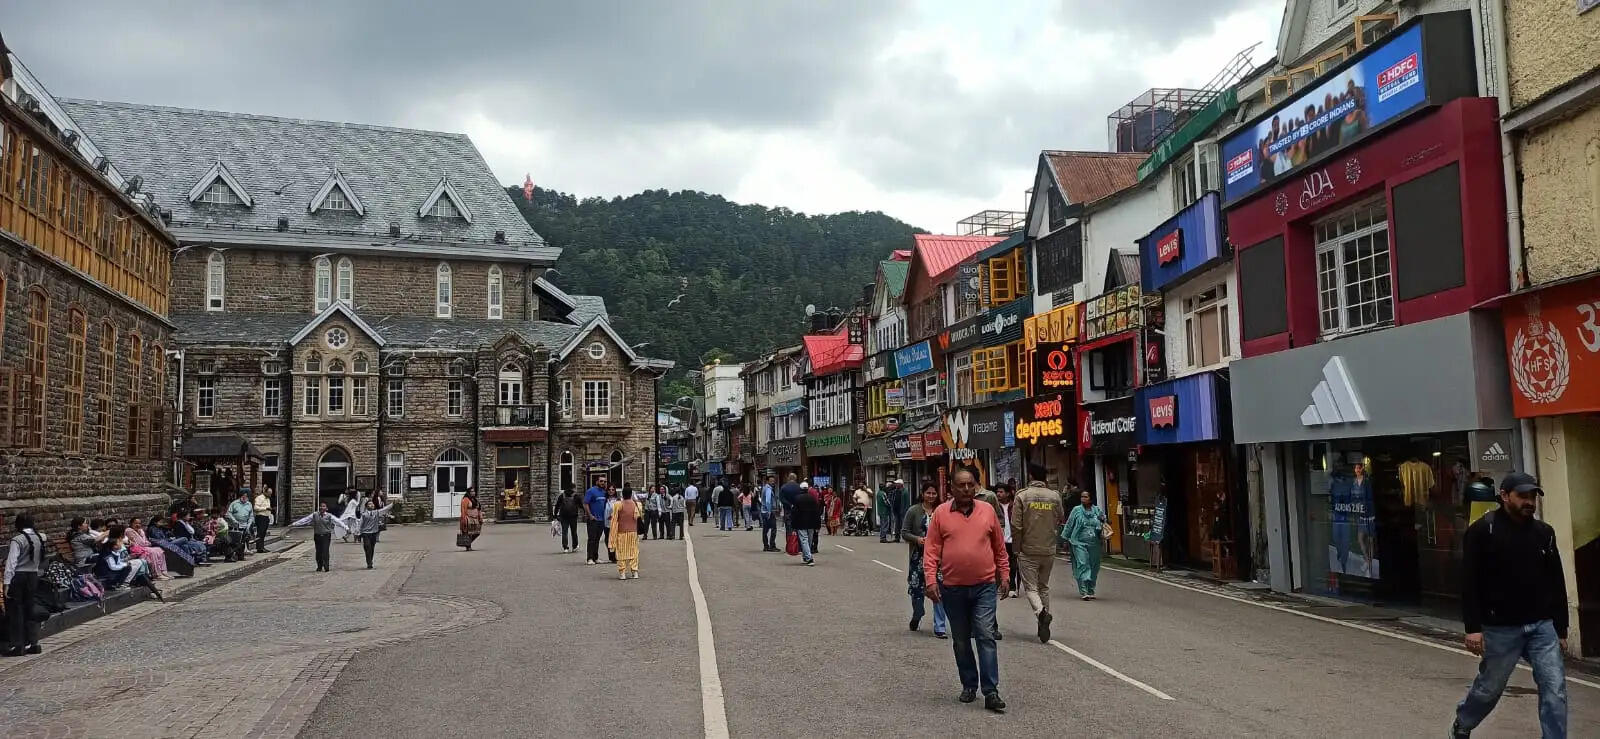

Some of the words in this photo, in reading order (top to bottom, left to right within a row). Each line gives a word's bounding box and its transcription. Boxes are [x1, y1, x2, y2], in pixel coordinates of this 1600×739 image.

[1387, 59, 1413, 80] HDFC
[1268, 133, 1292, 152] TRUSTED
[1292, 131, 1300, 141] BY
[1309, 115, 1329, 131] CRORE
[1329, 100, 1355, 119] INDIANS
[1300, 168, 1334, 210] ADA
[1528, 356, 1551, 373] HFS
[1042, 370, 1074, 380] xero
[1042, 379, 1074, 388] degrees
[1034, 400, 1061, 419] xero
[1016, 418, 1063, 445] degrees
[1091, 418, 1116, 436] Hideout
[771, 443, 798, 456] OCTAVE
[1030, 502, 1053, 511] POLICE
